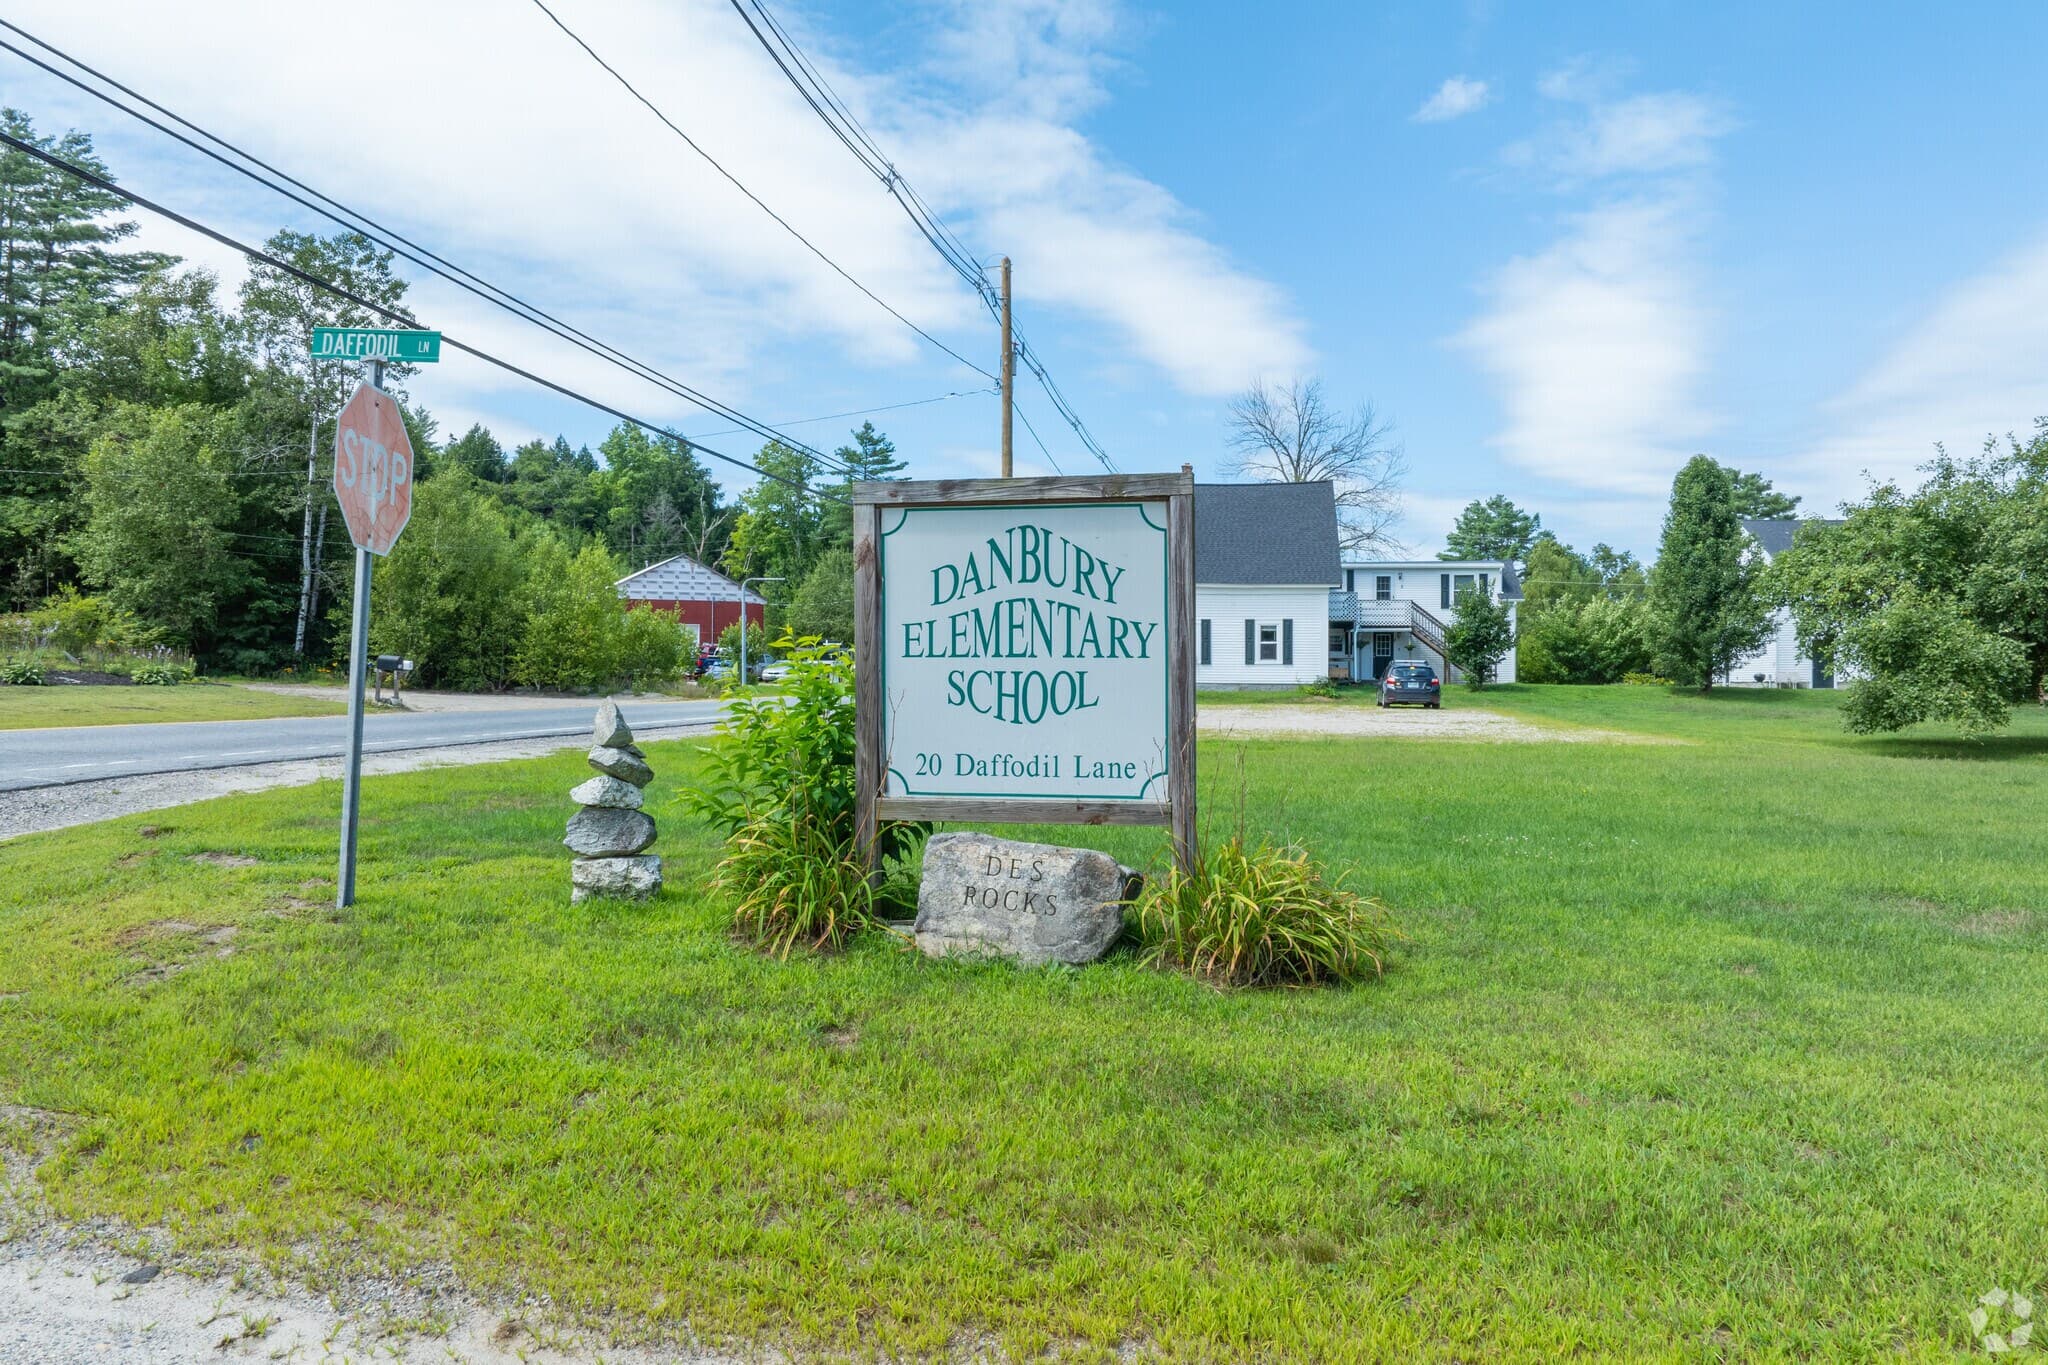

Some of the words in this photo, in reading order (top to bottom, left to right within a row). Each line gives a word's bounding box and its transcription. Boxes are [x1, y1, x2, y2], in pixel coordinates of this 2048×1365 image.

[322, 332, 402, 356] DAFFODIL
[418, 340, 430, 353] LN
[341, 428, 408, 506] STOP
[930, 524, 1126, 606] DANBURY
[901, 597, 1159, 659] ELEMENTARY
[947, 670, 1100, 725] SCHOOL
[915, 752, 942, 777] 20
[956, 753, 1061, 779] Daffodil
[1074, 755, 1137, 779] Lane
[986, 855, 1044, 882] DES
[963, 885, 1058, 916] ROCKS
